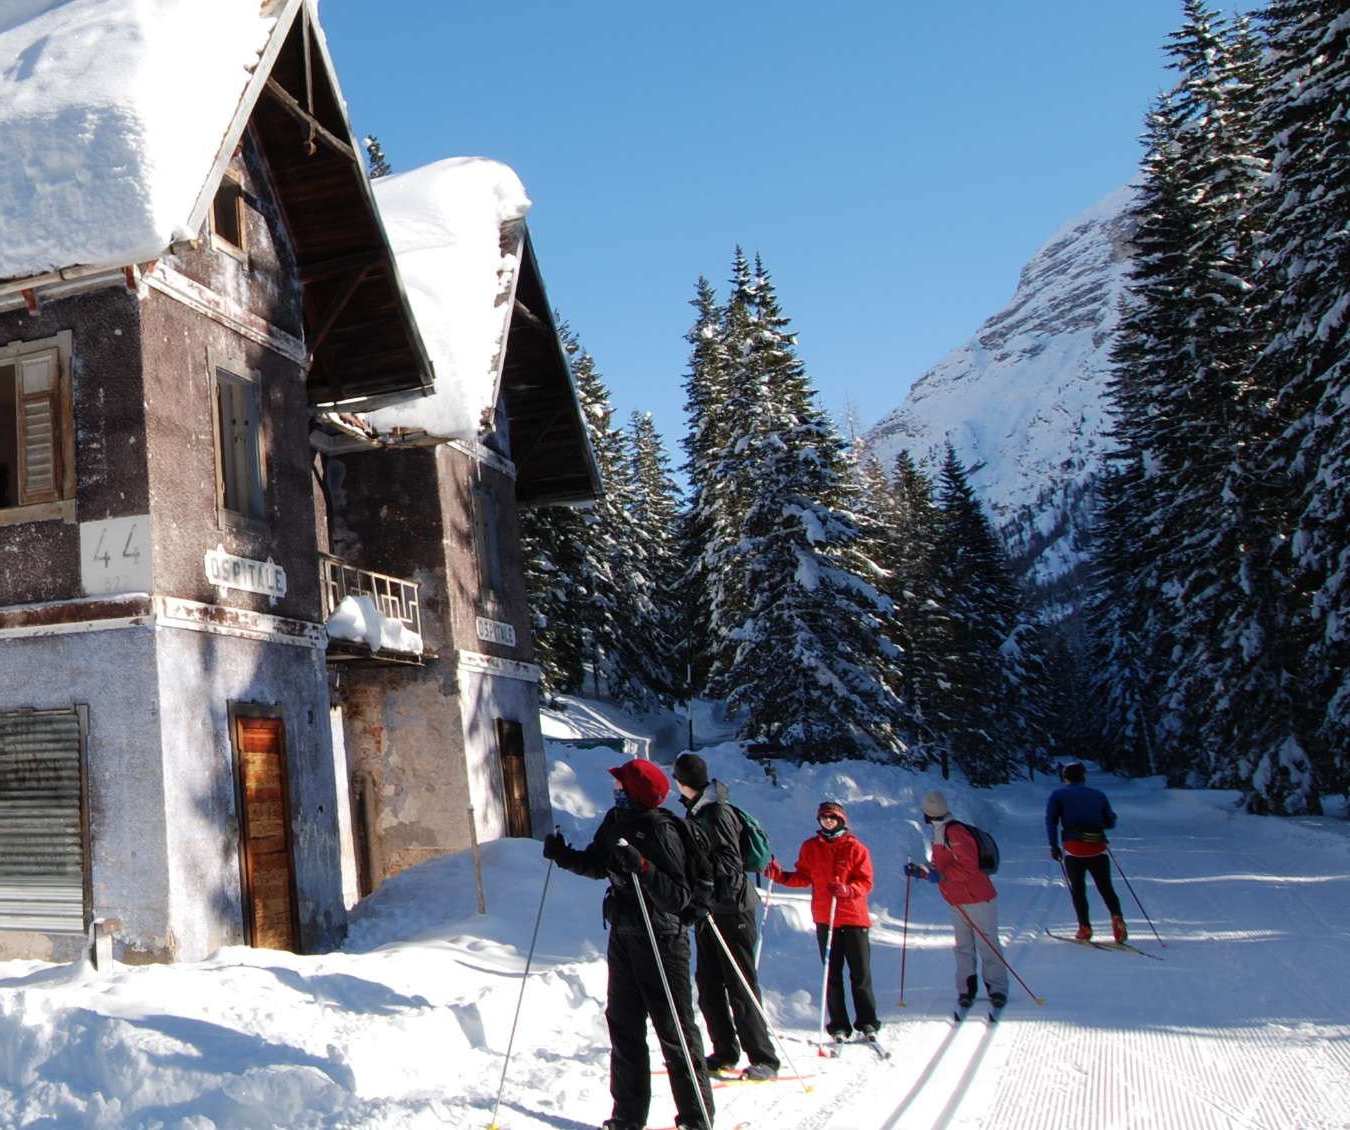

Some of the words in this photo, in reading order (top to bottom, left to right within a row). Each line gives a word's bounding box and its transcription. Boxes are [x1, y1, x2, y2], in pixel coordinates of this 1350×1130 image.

[92, 523, 141, 568] 44
[211, 557, 284, 592] OSPITALE
[479, 619, 514, 644] OSPITALE
